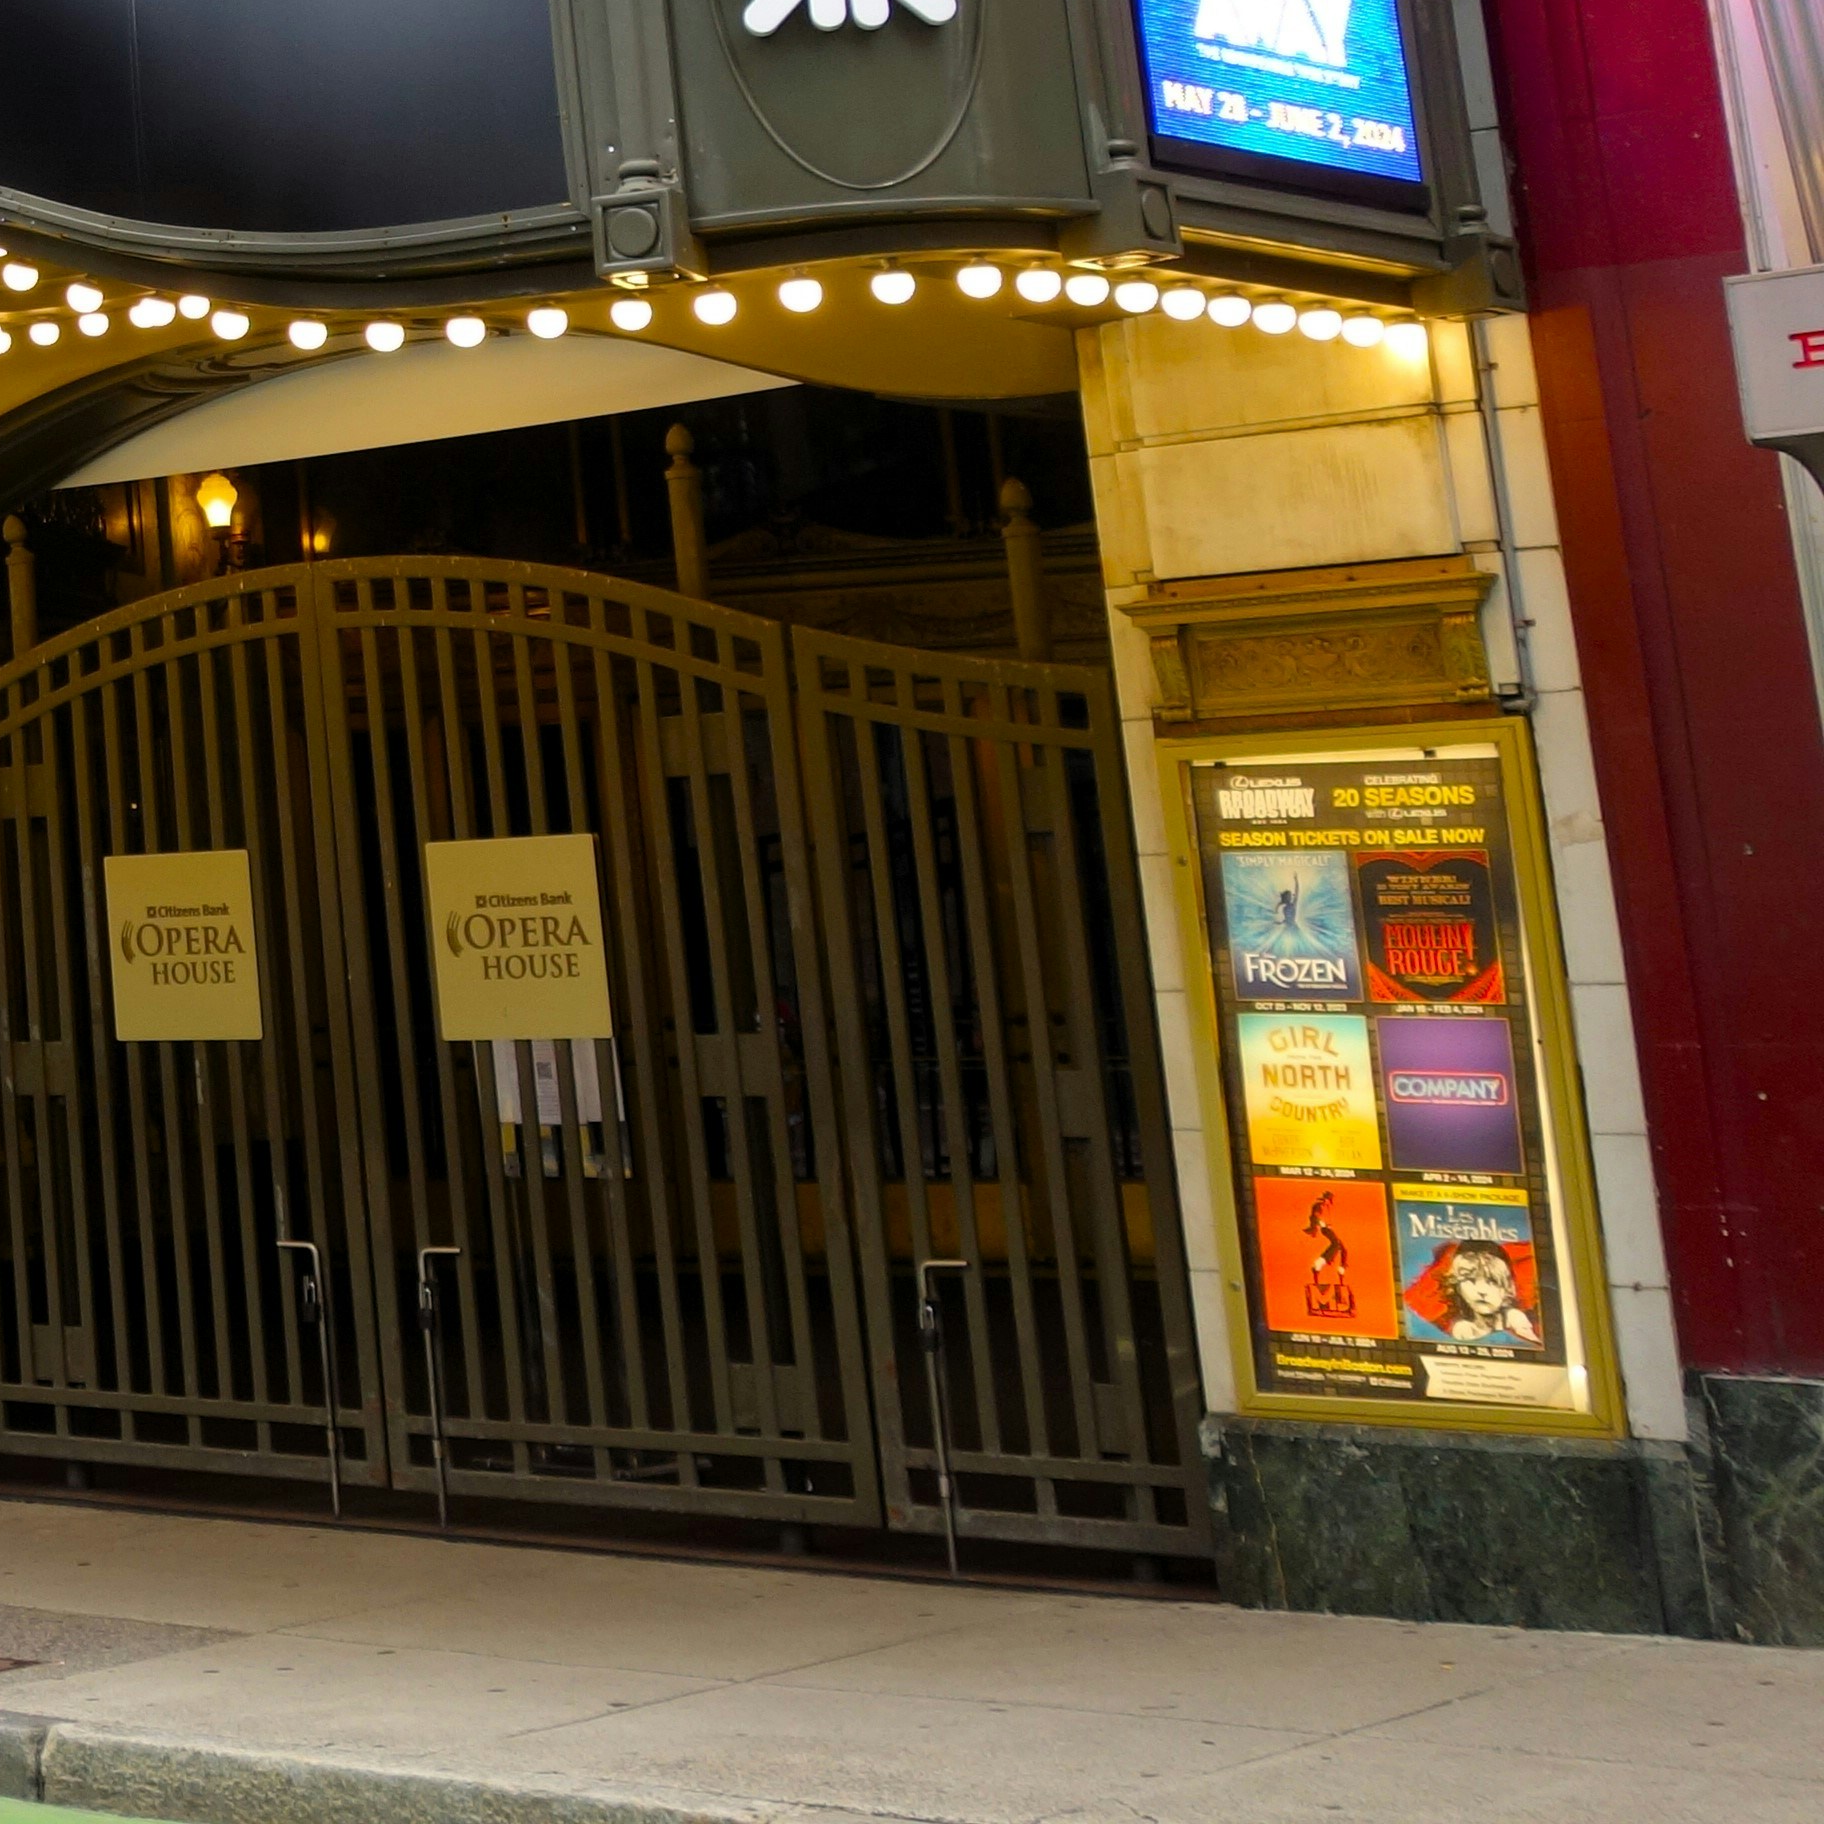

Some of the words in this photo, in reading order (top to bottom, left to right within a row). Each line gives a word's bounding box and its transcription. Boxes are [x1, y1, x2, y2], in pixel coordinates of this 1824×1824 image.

[1162, 80, 1214, 116] MAY
[1249, 777, 1302, 788] LEXUS
[1364, 774, 1439, 786] CELEBRATING
[1219, 788, 1315, 810] BROADWAY
[1333, 788, 1359, 807] 20
[1364, 786, 1475, 806] SEASONS
[1220, 832, 1286, 847] SEASON
[1289, 830, 1361, 846] TICKETS
[1364, 829, 1389, 845] ON
[1393, 829, 1439, 845] SALE
[1442, 828, 1485, 844] NOW
[158, 905, 201, 919] Citizens
[203, 903, 230, 917] Bank
[488, 893, 538, 909] Citizens
[541, 891, 573, 906] Bank
[136, 923, 246, 958] OPERA
[464, 913, 591, 950] OPERA
[1384, 923, 1462, 949] MOULIN
[152, 961, 236, 986] HOUSE
[482, 953, 581, 980] HOUSE
[1244, 953, 1347, 989] FROZEN
[1268, 1026, 1339, 1057] GIRL
[1262, 1063, 1352, 1090] NORTH
[1394, 1077, 1501, 1100] COMPANY
[1270, 1096, 1350, 1122] COUNTRY
[1446, 1205, 1475, 1223] Les
[1309, 1284, 1351, 1313] MJ
